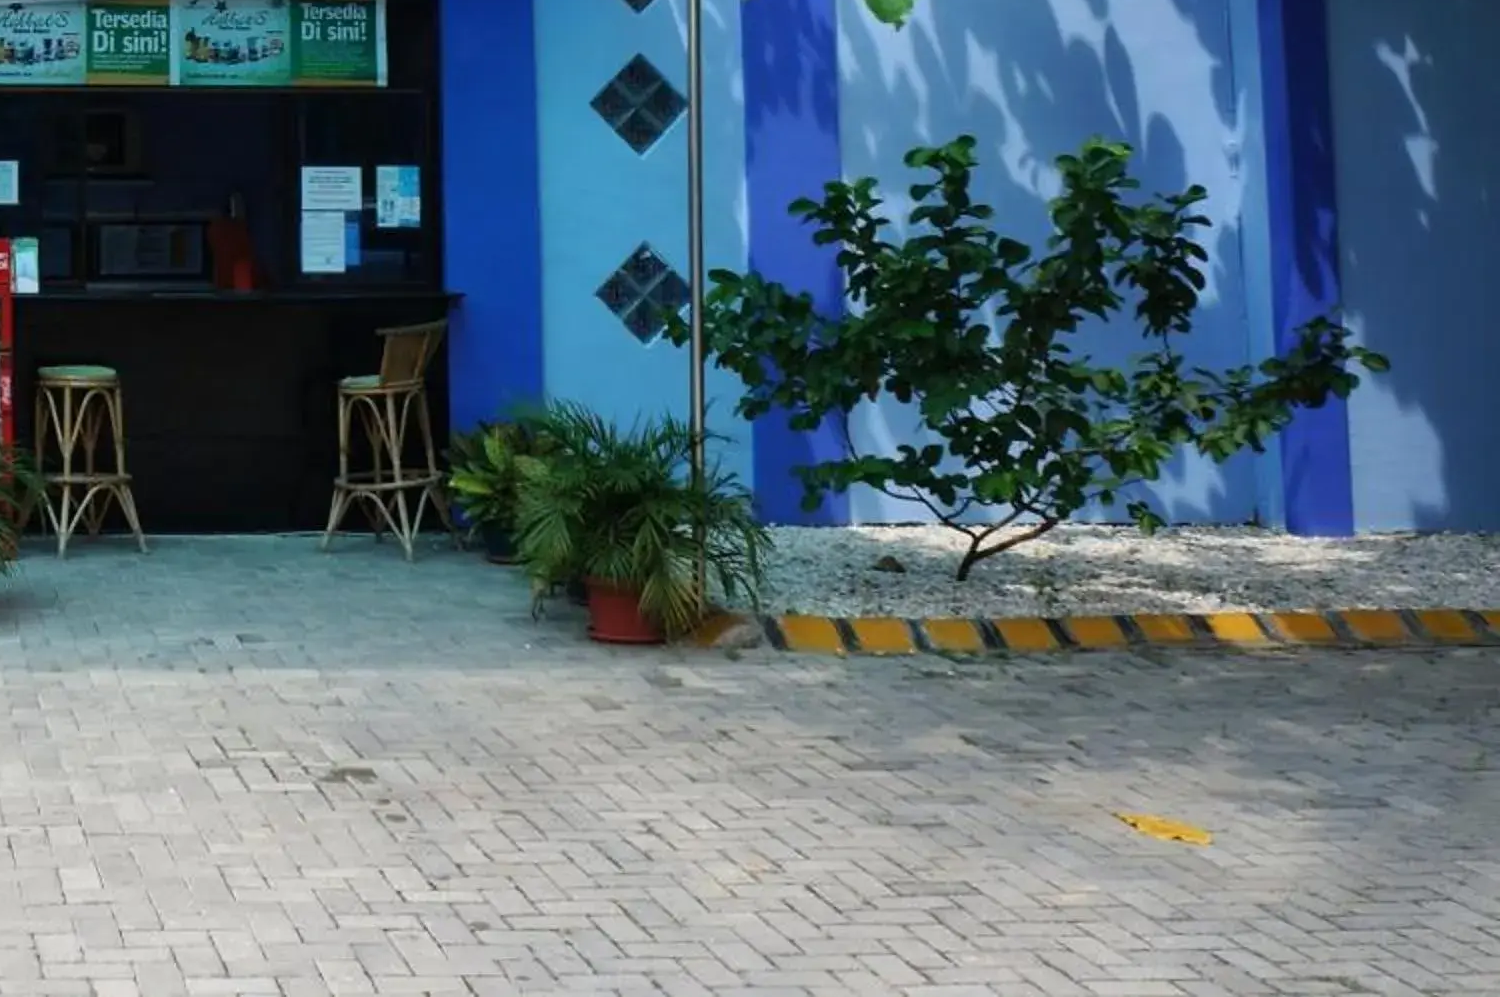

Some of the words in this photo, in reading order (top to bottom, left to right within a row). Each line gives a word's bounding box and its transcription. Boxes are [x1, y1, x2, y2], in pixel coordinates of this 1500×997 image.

[92, 9, 167, 28] Tersedia
[300, 2, 368, 21] Tersedia
[301, 22, 320, 41] Di
[327, 21, 368, 41] sini!
[93, 30, 115, 53] Di
[122, 30, 167, 53] sini!
